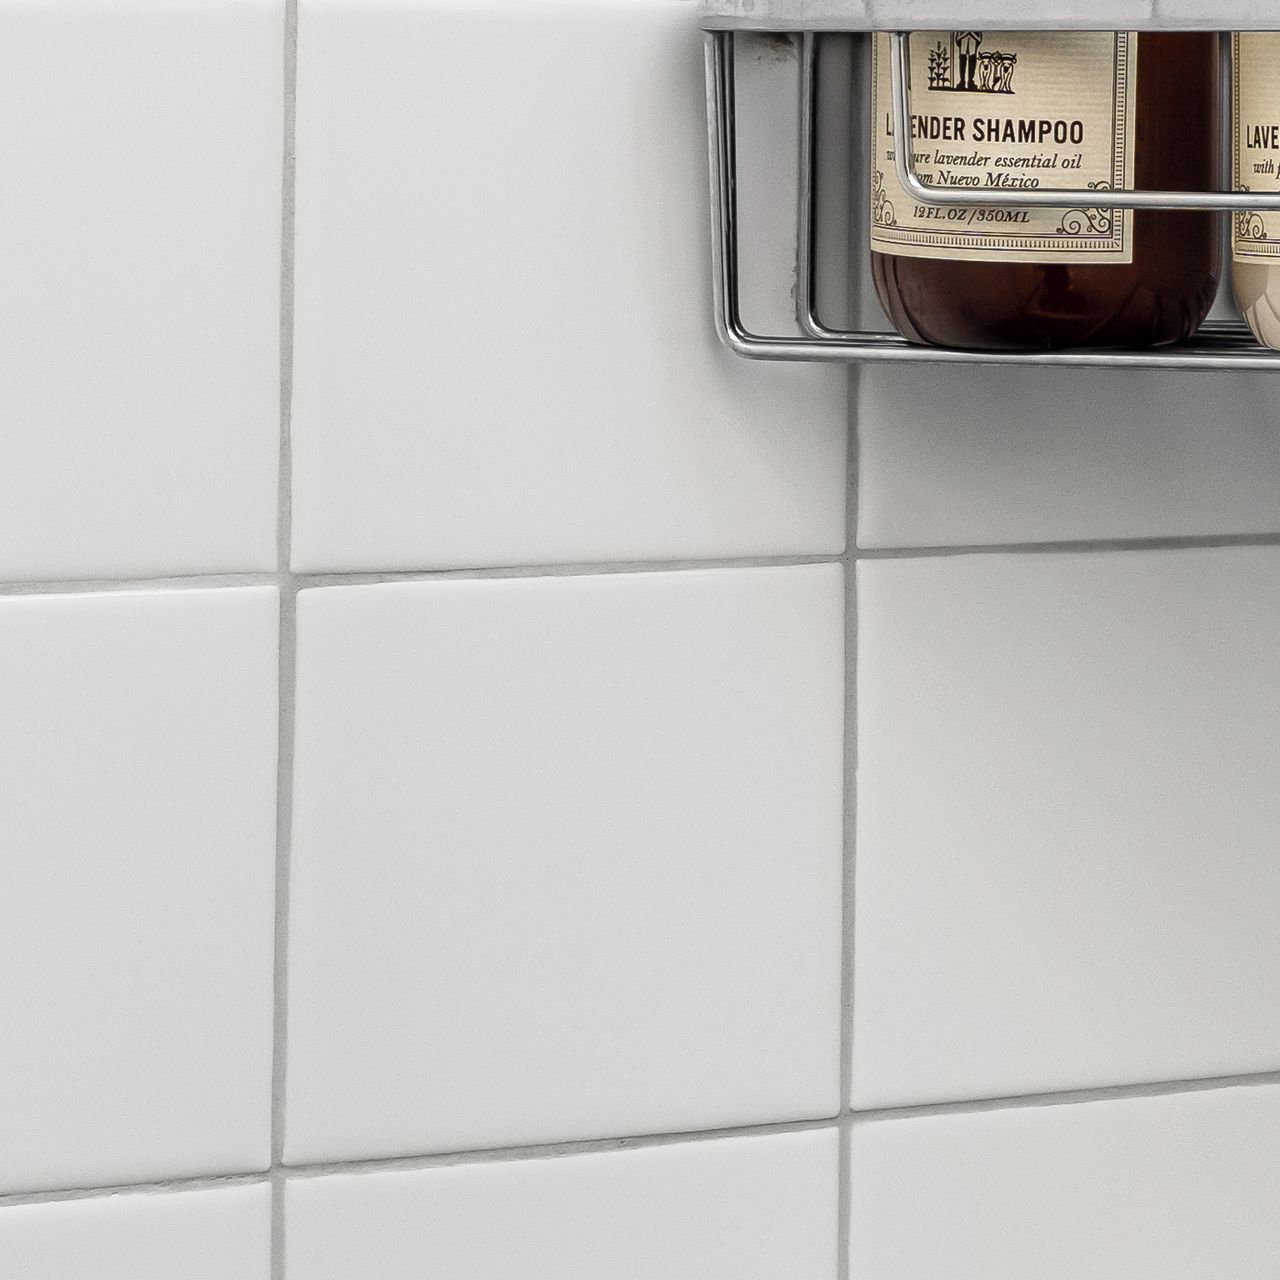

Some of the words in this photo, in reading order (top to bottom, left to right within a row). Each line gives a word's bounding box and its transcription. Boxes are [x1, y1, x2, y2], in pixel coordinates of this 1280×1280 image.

[886, 113, 966, 140] LENDER
[972, 118, 1084, 144] SHAMPOO
[934, 150, 990, 168] lavender
[994, 152, 1057, 168] essential
[1061, 154, 1082, 169] oil
[1253, 159, 1275, 174] with
[936, 171, 980, 186] Nuevo
[984, 173, 1040, 188] México
